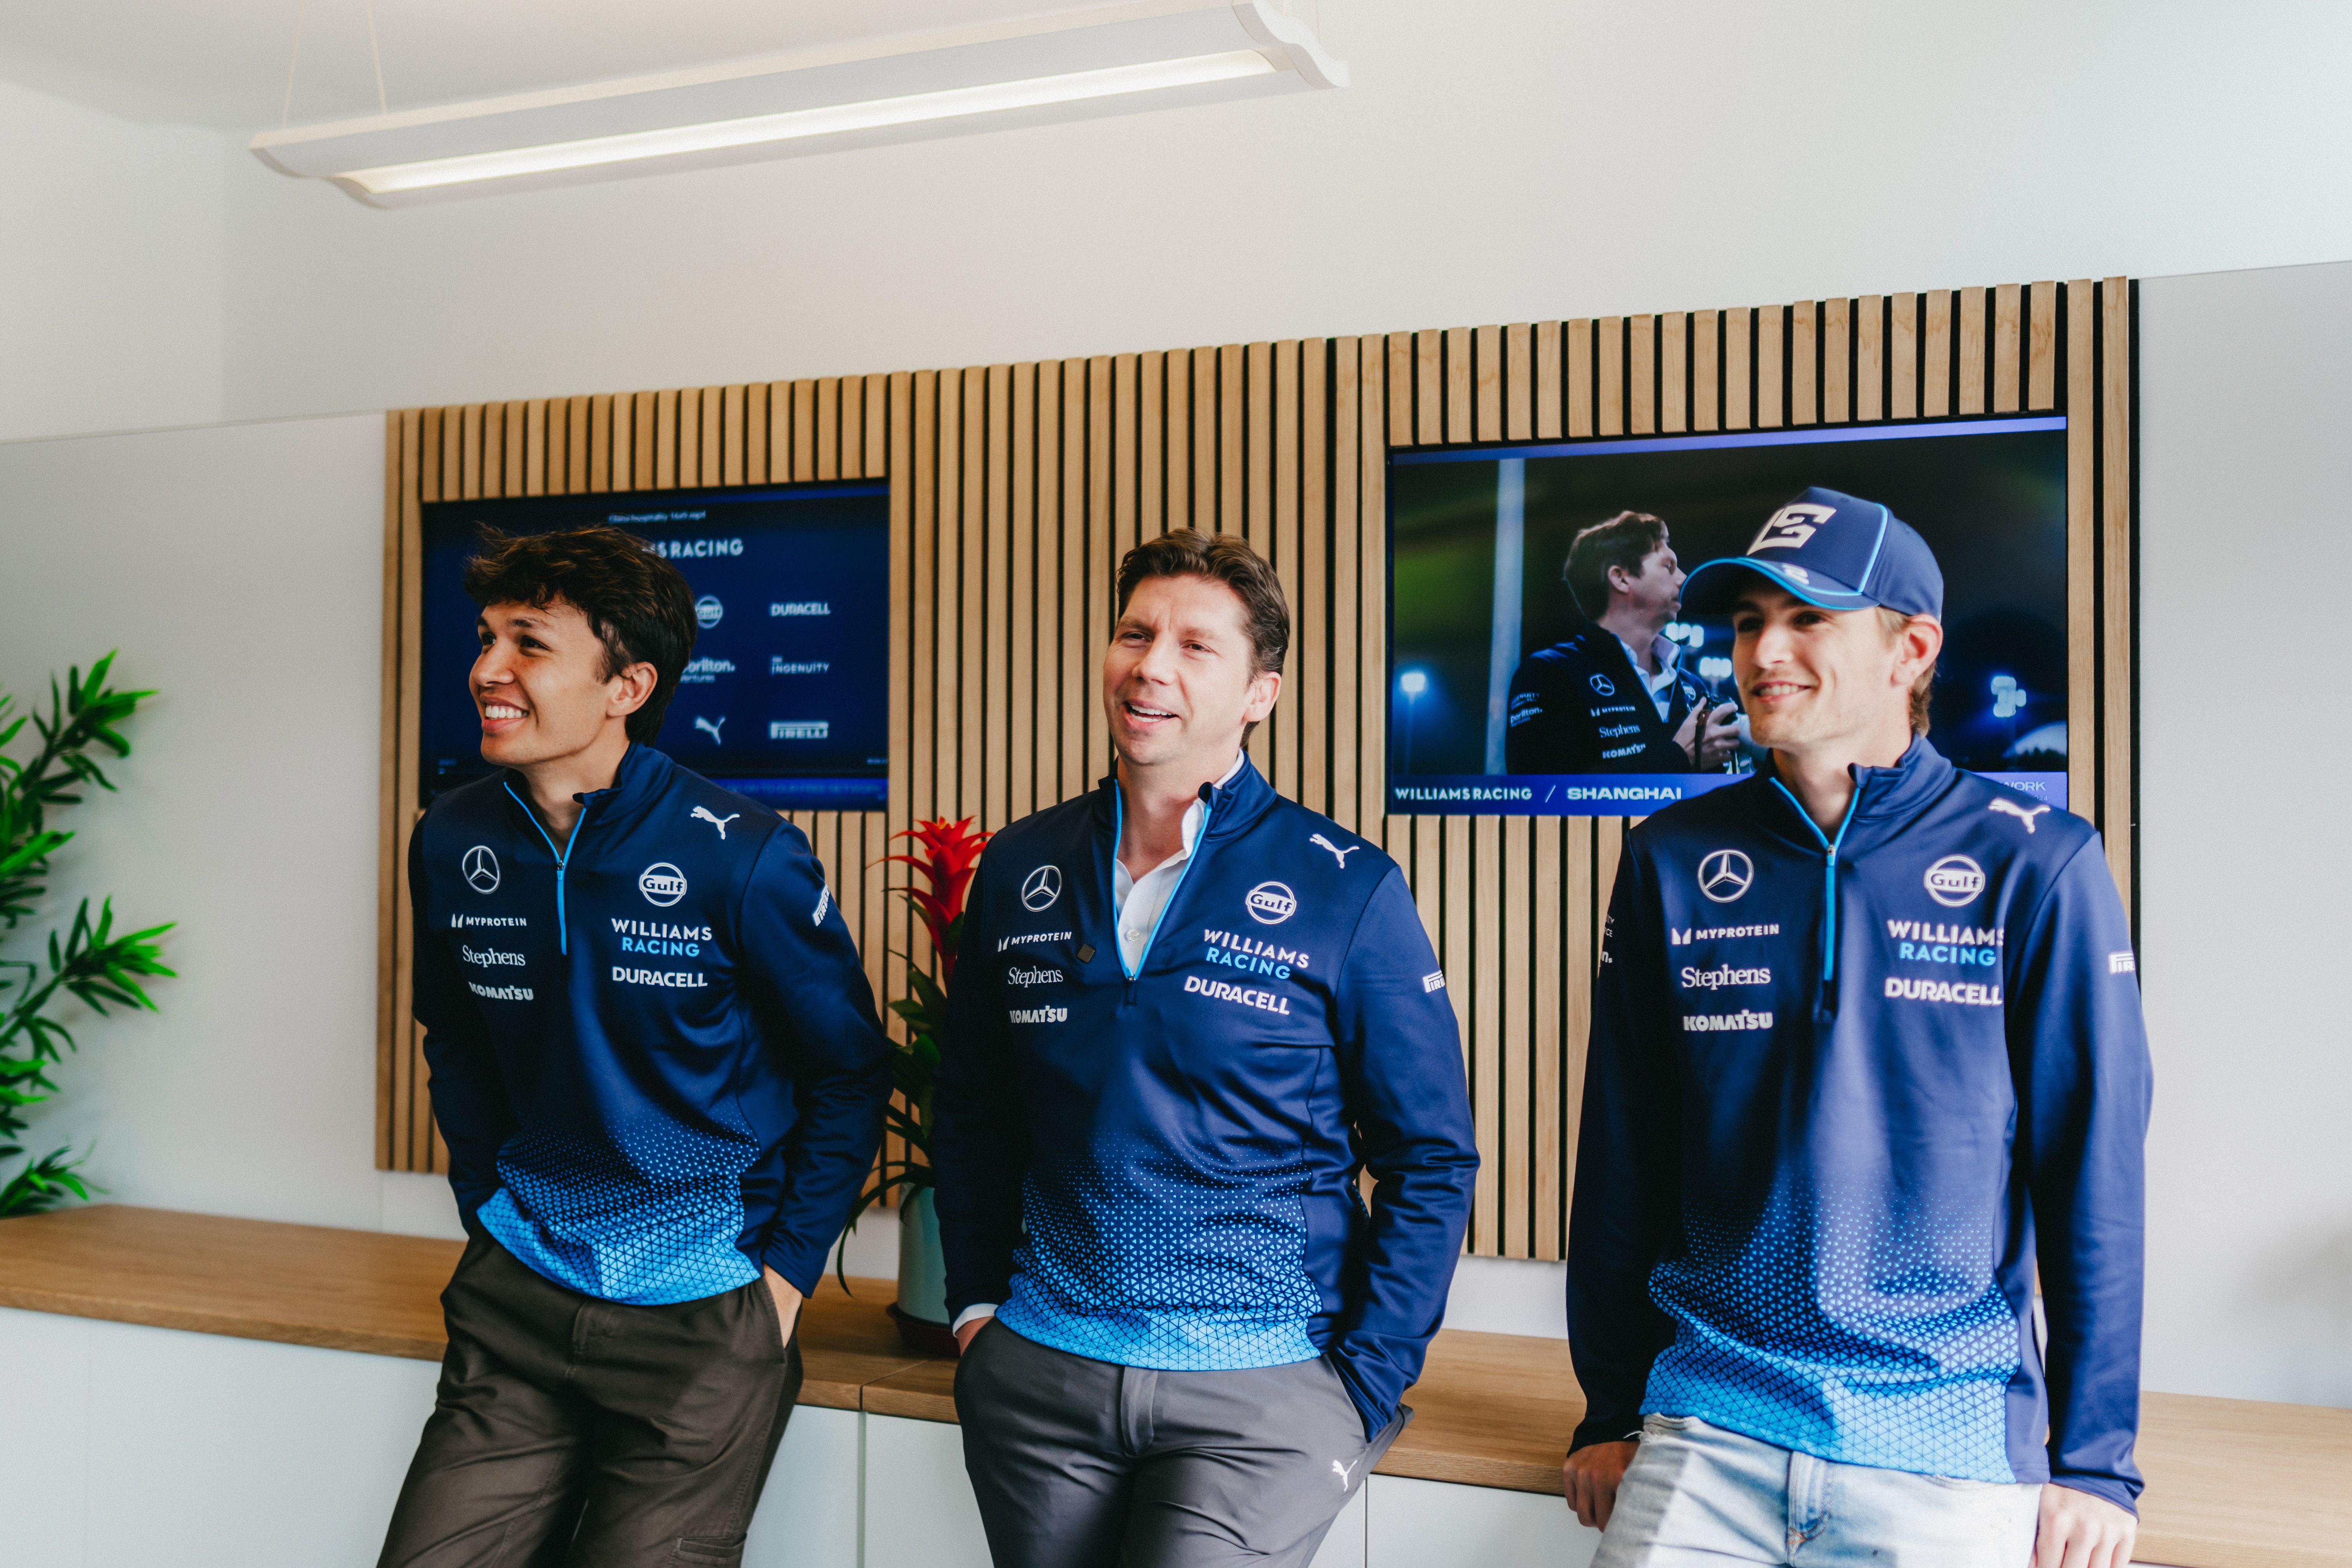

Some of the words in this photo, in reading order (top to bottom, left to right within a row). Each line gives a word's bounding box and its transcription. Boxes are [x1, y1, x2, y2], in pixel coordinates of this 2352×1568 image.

[771, 602, 831, 616] DURACELL
[1567, 787, 1682, 800] SHANGHAI
[642, 877, 684, 892] Gulf
[1931, 873, 1980, 888] Gulf
[1250, 893, 1293, 913] Gulf
[466, 916, 527, 927] MYPROTEIN
[611, 918, 712, 941] WILLIAMS
[1696, 924, 1779, 940] MYPROTEIN
[622, 936, 700, 957] RACING
[1011, 931, 1072, 945] MYPROTEIN
[1203, 929, 1310, 968] WILLIAMS
[463, 944, 526, 968] Stephens
[1206, 947, 1291, 979] RACING
[1899, 941, 1997, 967] RACING
[612, 966, 708, 988] DURACELL
[1008, 965, 1064, 988] Stephens
[1680, 964, 1772, 990] Stephens
[468, 981, 534, 1001] KOMATSU
[1183, 975, 1290, 1015] DURACELL
[1885, 976, 2003, 1006] DURACELL
[1009, 1005, 1068, 1024] KOMATSU
[1683, 1009, 1773, 1031] KOMATSU
